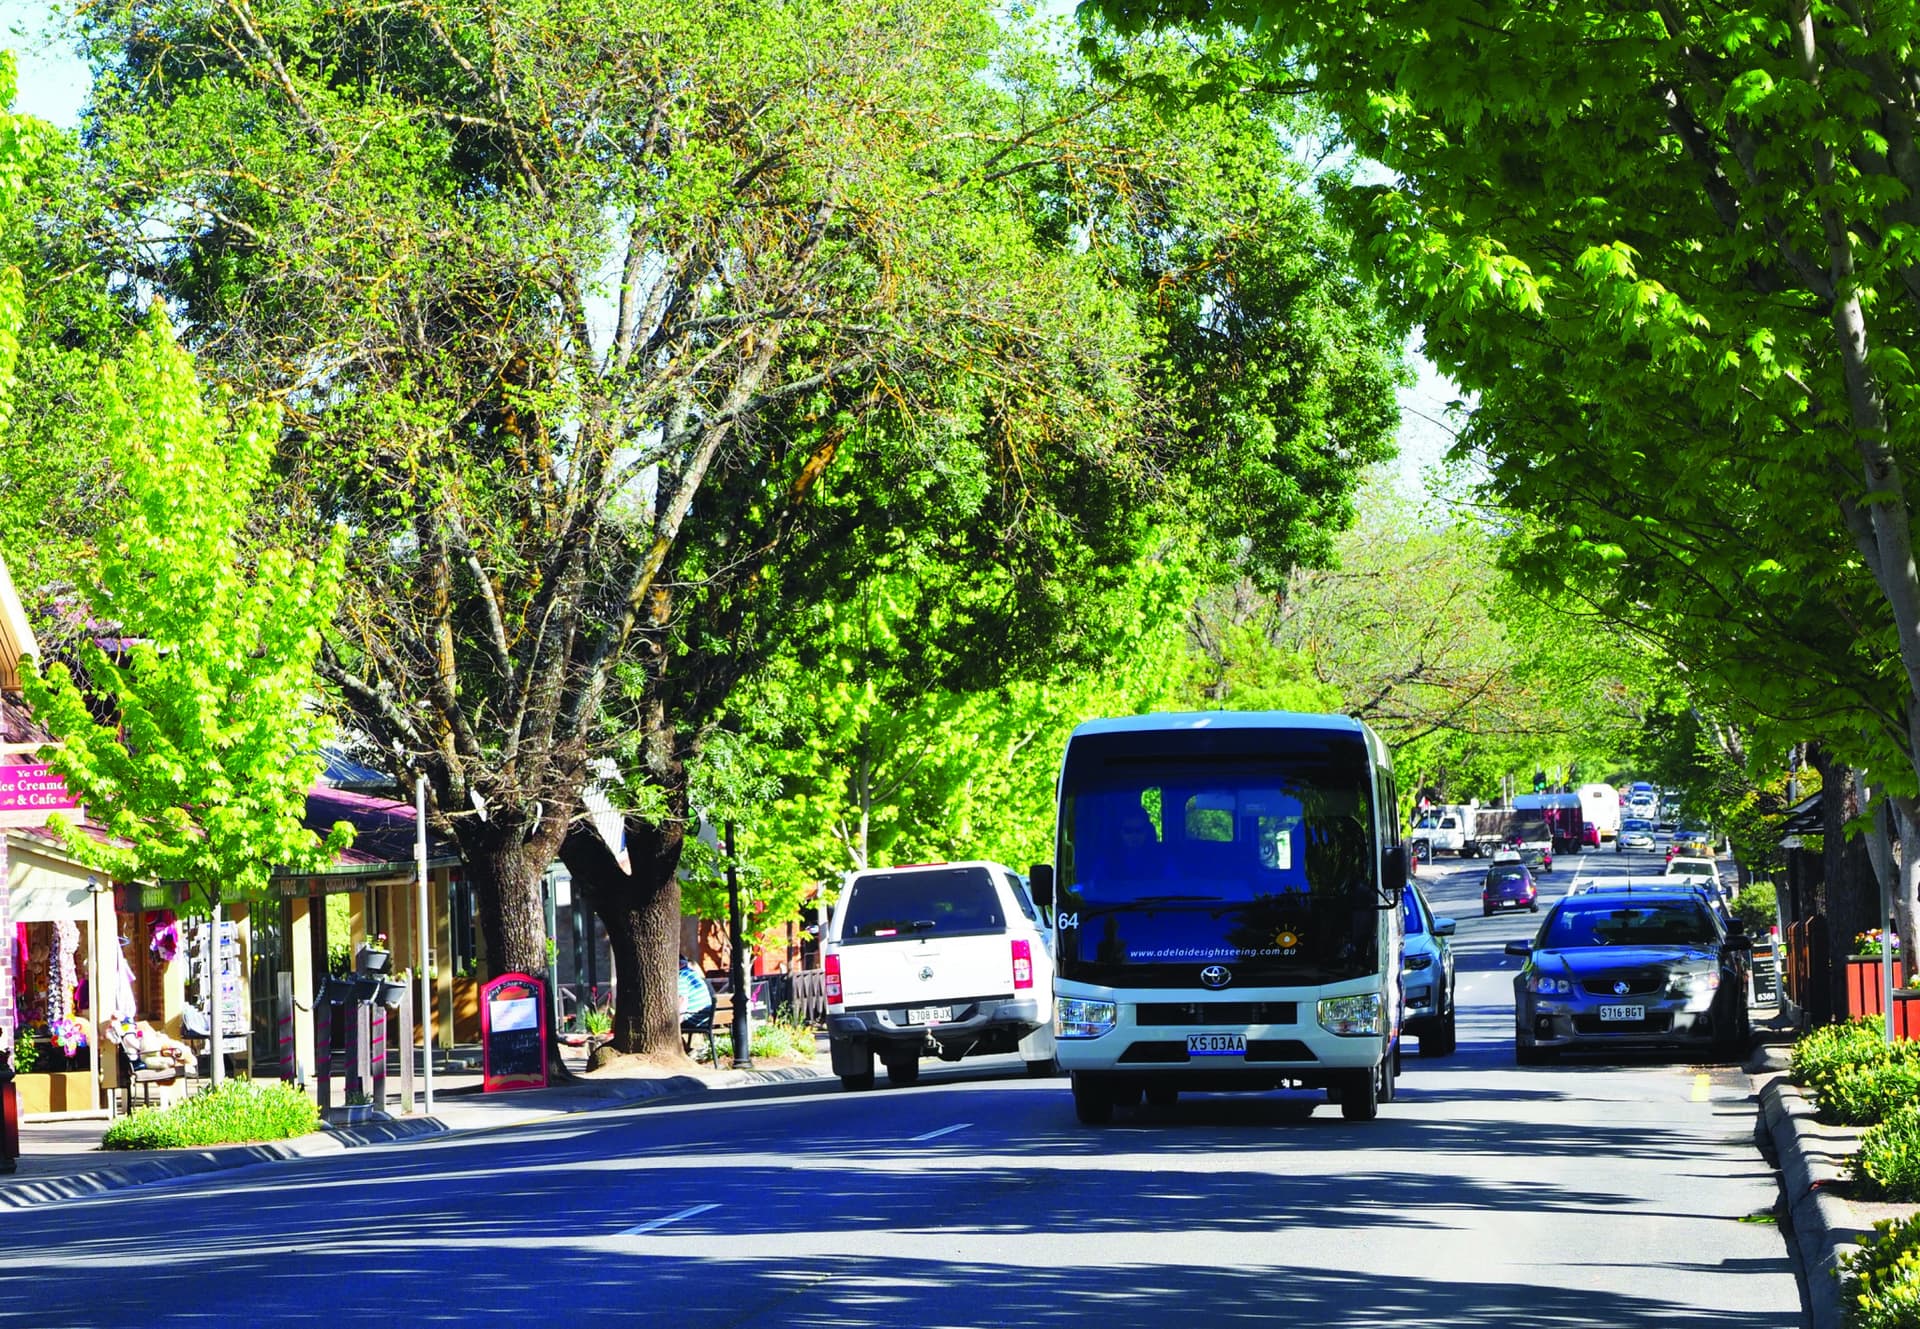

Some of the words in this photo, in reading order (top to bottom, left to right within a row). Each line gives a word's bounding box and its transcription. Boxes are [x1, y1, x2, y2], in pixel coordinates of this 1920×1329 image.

[16, 769, 30, 778] Ye
[33, 769, 54, 777] Ol
[0, 780, 15, 791] ce
[18, 780, 68, 791] Creamer
[17, 794, 27, 805] &
[29, 793, 57, 805] Cafe
[1058, 912, 1079, 929] 64
[1130, 947, 1296, 958] www.adelaidesightseeing.com.au
